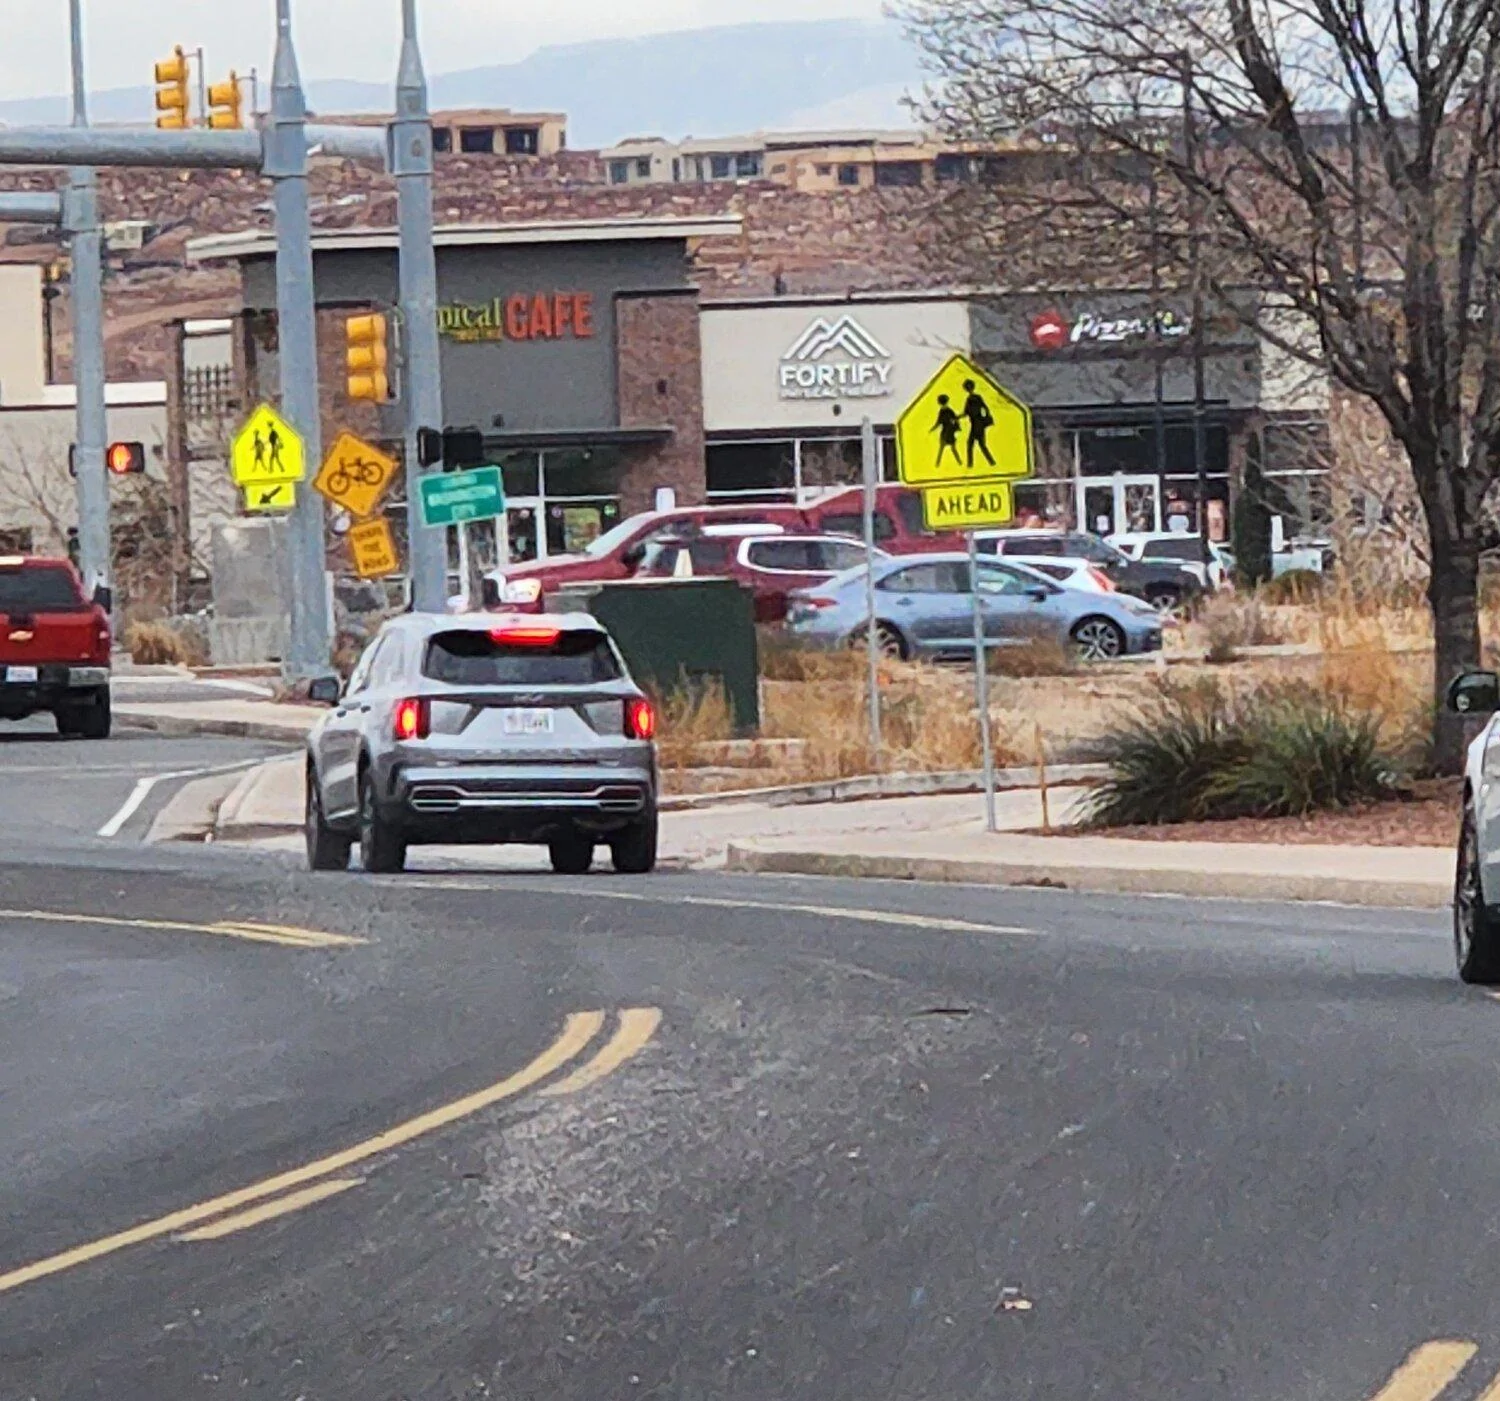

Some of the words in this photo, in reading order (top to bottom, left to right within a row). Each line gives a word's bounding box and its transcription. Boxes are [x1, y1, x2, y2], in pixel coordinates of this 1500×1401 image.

[437, 297, 501, 332] pical
[505, 290, 595, 340] CAFE
[780, 362, 892, 387] FORTIFY
[937, 492, 1002, 516] AHEAD
